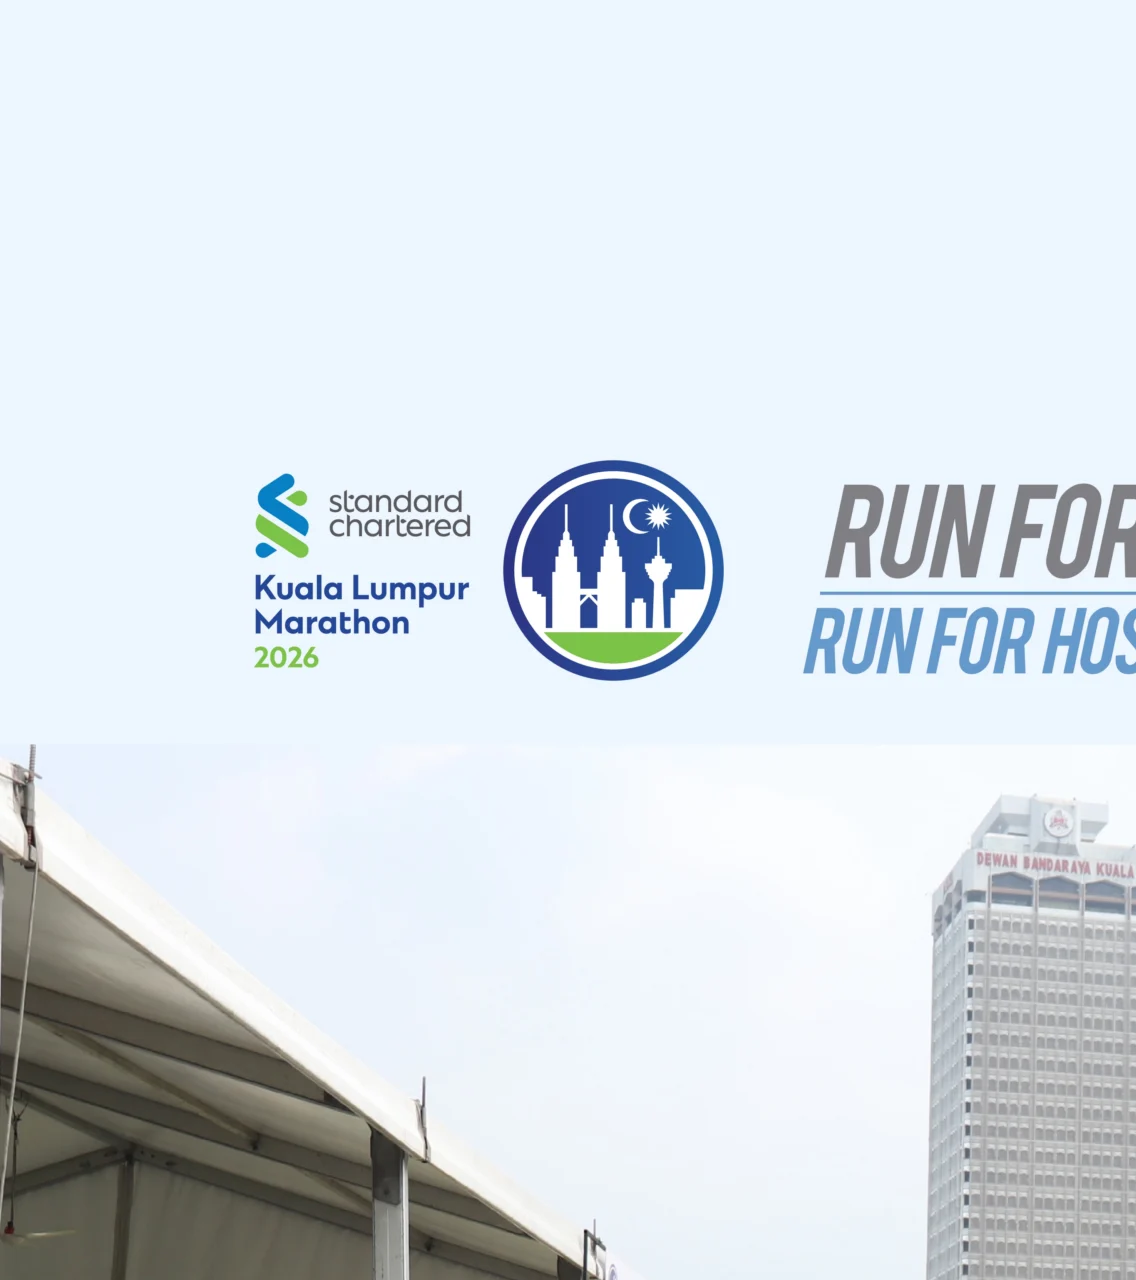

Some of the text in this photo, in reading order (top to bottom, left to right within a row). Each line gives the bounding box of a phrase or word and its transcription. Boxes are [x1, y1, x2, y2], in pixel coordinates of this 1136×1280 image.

[976, 851, 1018, 868] DEWAN
[1023, 856, 1092, 875] BANDARAYA
[1096, 862, 1135, 879] KUALA
